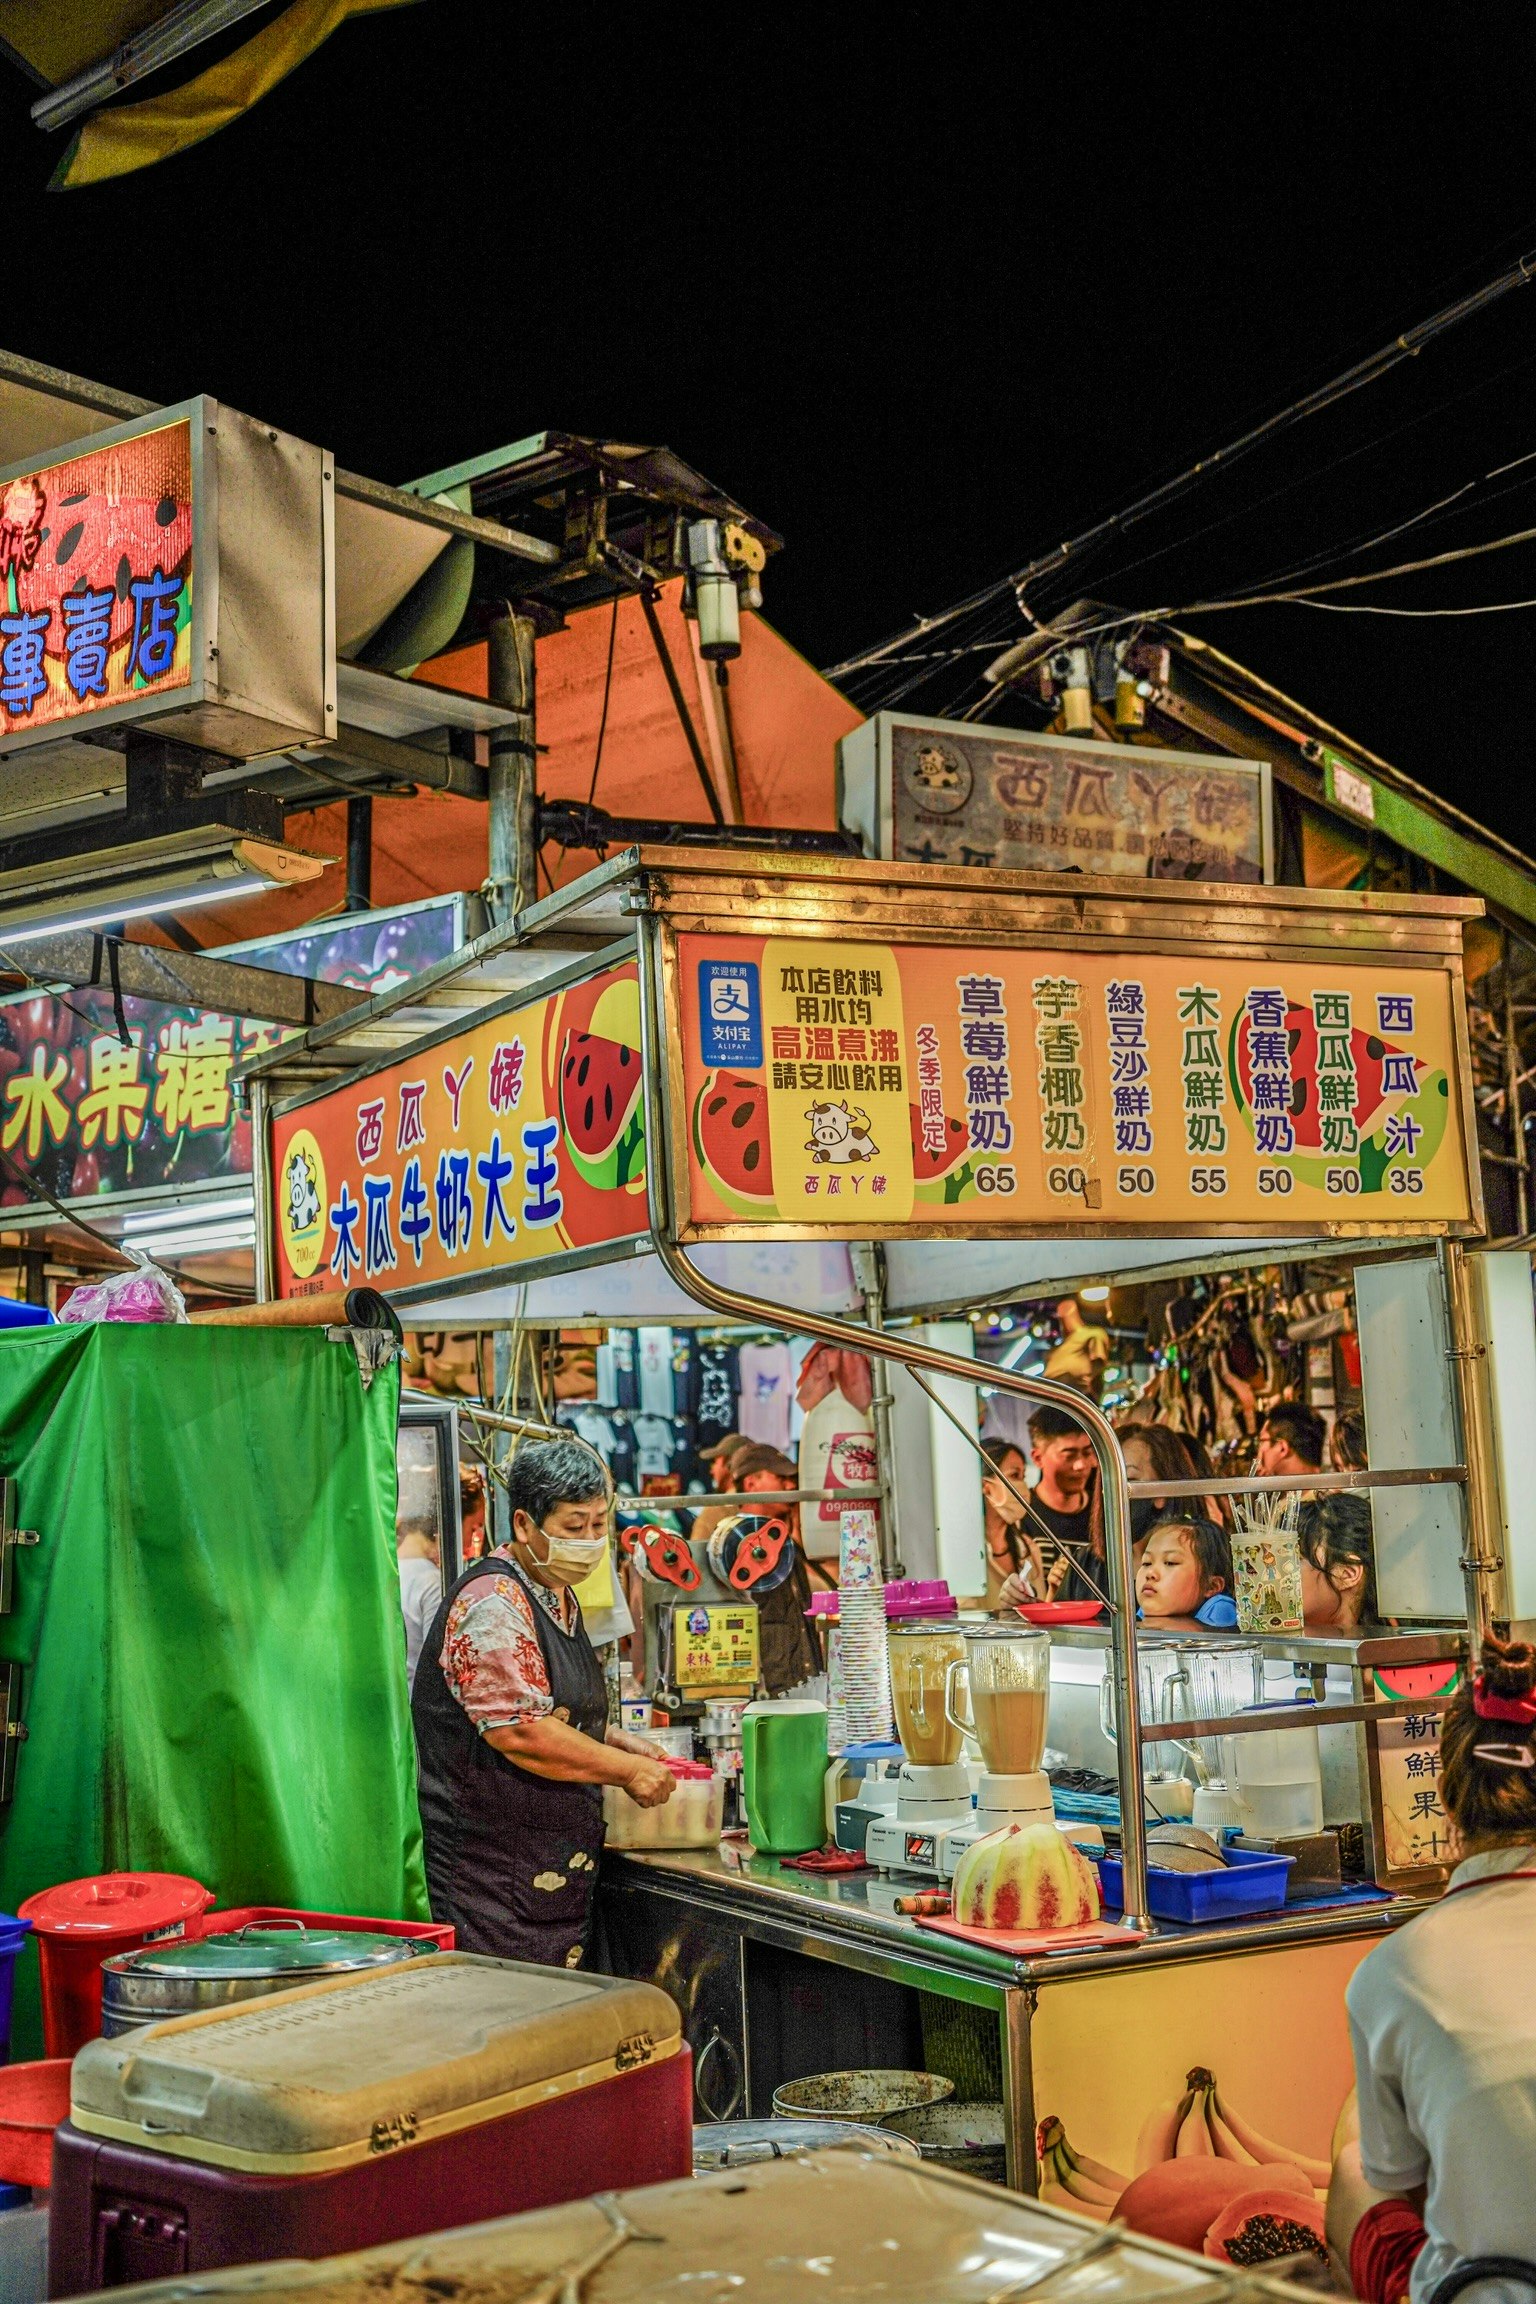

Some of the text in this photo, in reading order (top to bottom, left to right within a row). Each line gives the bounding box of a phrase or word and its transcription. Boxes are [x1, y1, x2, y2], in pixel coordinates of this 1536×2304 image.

[711, 966, 747, 977] 欢迎使用
[780, 966, 883, 996] 本店飲料
[796, 997, 873, 1025] 用水均
[712, 1025, 750, 1041] 支付宝
[771, 1026, 900, 1062] 高溫煮沸
[772, 1062, 903, 1092] 請安心飲用
[958, 977, 1012, 1150] 草莓鮮奶
[1031, 979, 1085, 1151] 芋香椰奶
[1106, 982, 1152, 1152] 綠豆沙鮮奶
[1178, 986, 1227, 1152] 木瓜鮮奶
[1247, 990, 1294, 1153] 香蕉鮮奶
[1313, 993, 1358, 1153] 西瓜鮮奶
[1377, 996, 1421, 1154] 西瓜汁
[2, 1012, 303, 1156] 水果糖
[357, 1039, 524, 1162] 西瓜丫姨
[916, 1026, 947, 1150] 冬季限定
[976, 1167, 1015, 1193] 65
[1049, 1168, 1084, 1193] 60
[1119, 1168, 1155, 1194] 50
[1191, 1169, 1227, 1194] 55
[1258, 1169, 1293, 1194] 50
[1326, 1169, 1360, 1194] 50
[1390, 1170, 1424, 1194] 35
[330, 1124, 562, 1280] 木瓜牛奶大王
[1403, 1712, 1450, 1859] 新鮮果汁
